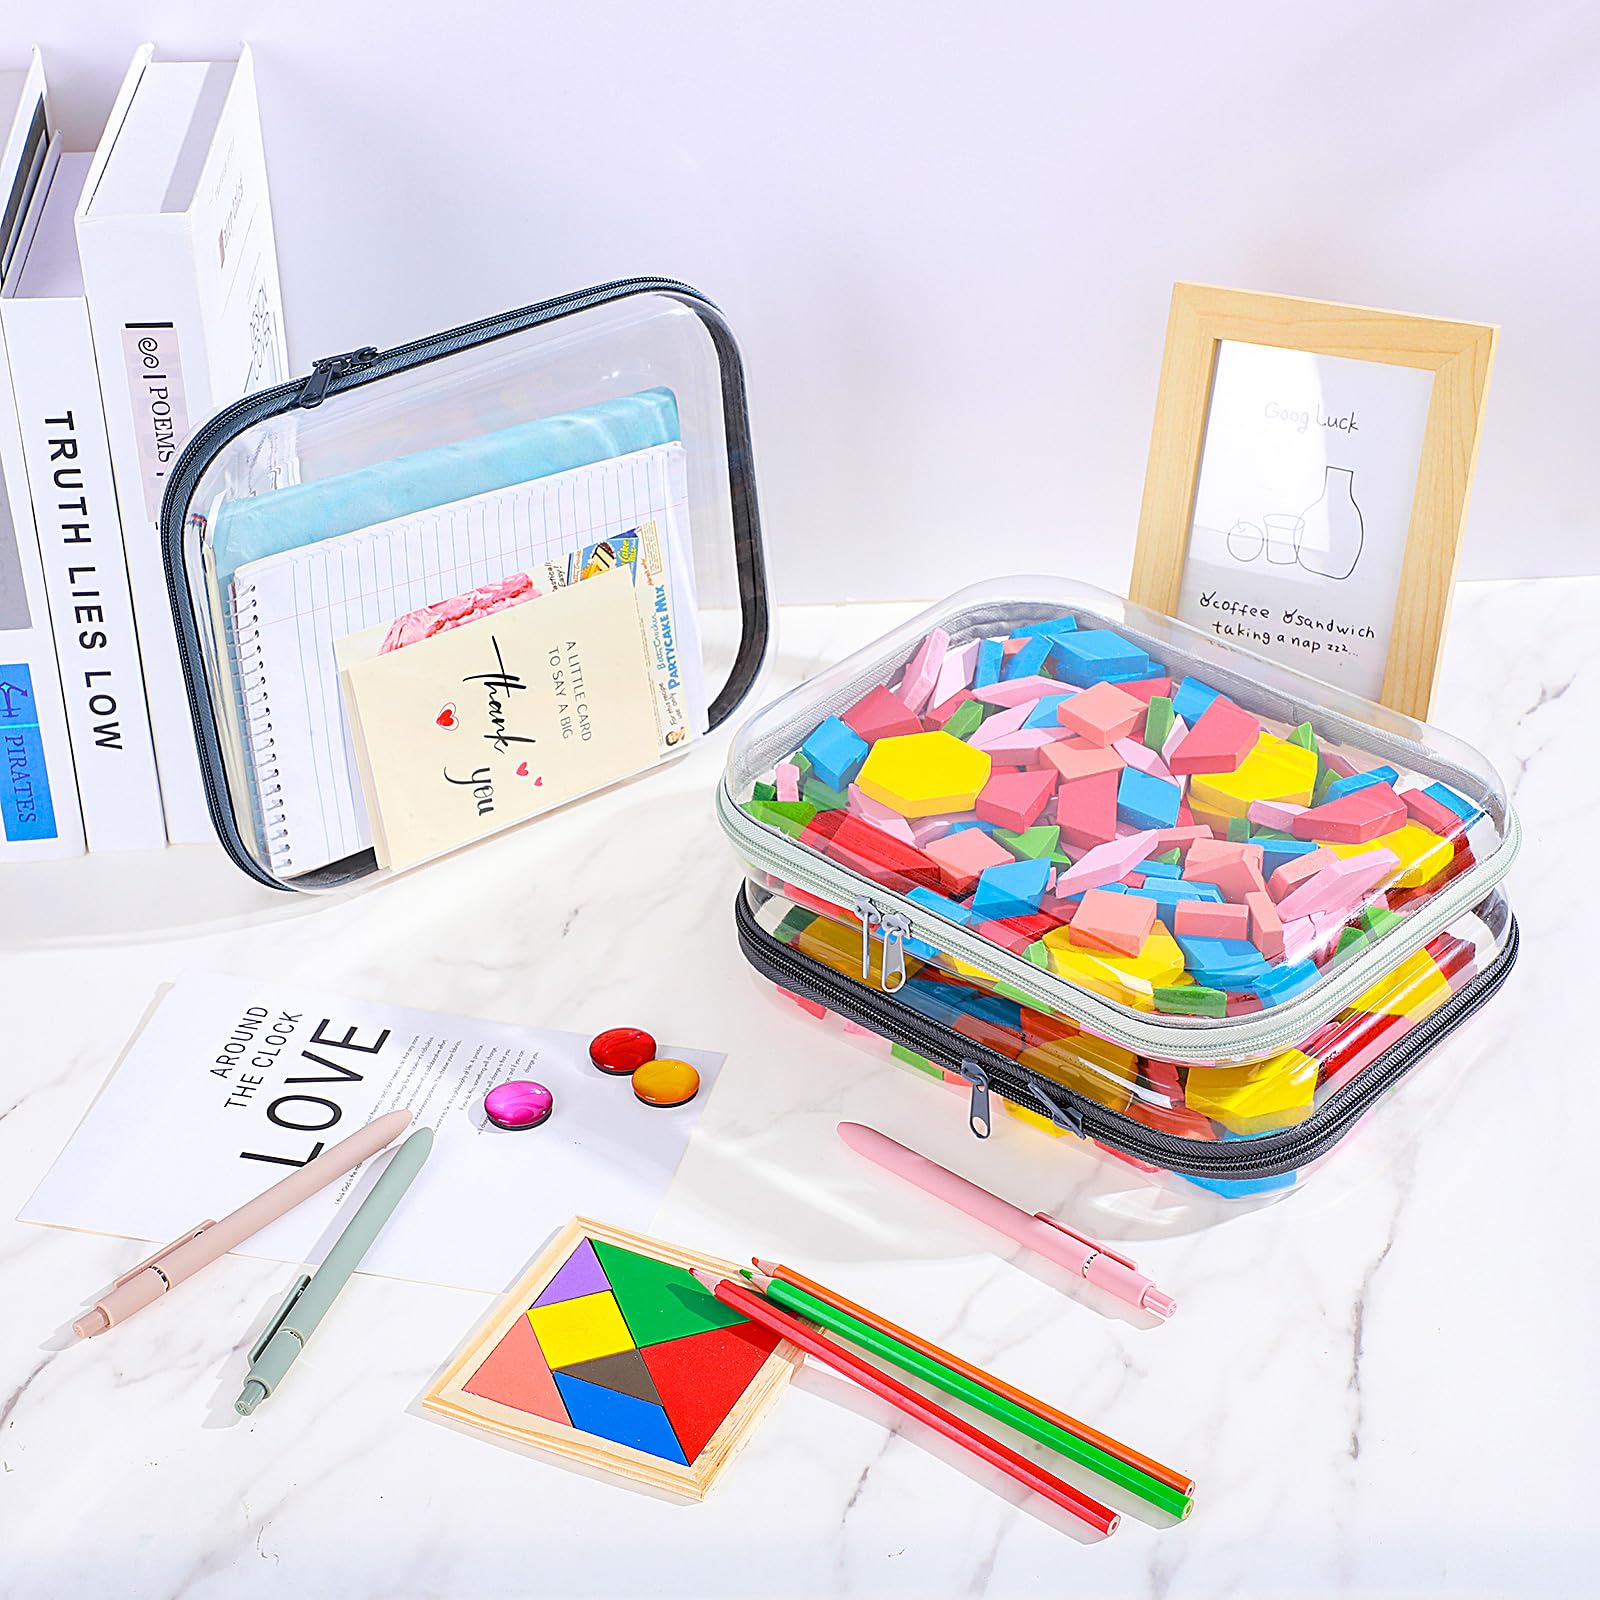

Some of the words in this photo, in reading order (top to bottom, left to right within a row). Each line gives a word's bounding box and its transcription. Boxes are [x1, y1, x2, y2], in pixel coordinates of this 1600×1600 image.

[150, 386, 174, 464] POEMS
[1316, 403, 1359, 433] Luck
[44, 411, 92, 544] TRUTH
[68, 567, 107, 650] LIES
[1213, 600, 1270, 619] coffee
[1295, 614, 1375, 639] sandwich
[548, 646, 561, 667] TO
[566, 641, 577, 651] A
[660, 614, 680, 690] PARTYCAKE
[1213, 621, 1271, 645] taking
[1276, 634, 1285, 643] a
[1291, 636, 1321, 653] nap
[552, 670, 567, 697] SAY
[568, 654, 586, 702] LITTLE
[84, 671, 123, 751] LOW
[558, 704, 569, 714] A
[560, 716, 573, 740] BIG
[577, 703, 592, 742] CARD
[5, 735, 37, 824] PIRATES
[443, 766, 495, 816] you
[210, 1006, 268, 1079] AROUND
[223, 1073, 264, 1108] THE
[251, 1011, 303, 1068] CLOCK
[239, 1018, 392, 1168] LOVE
